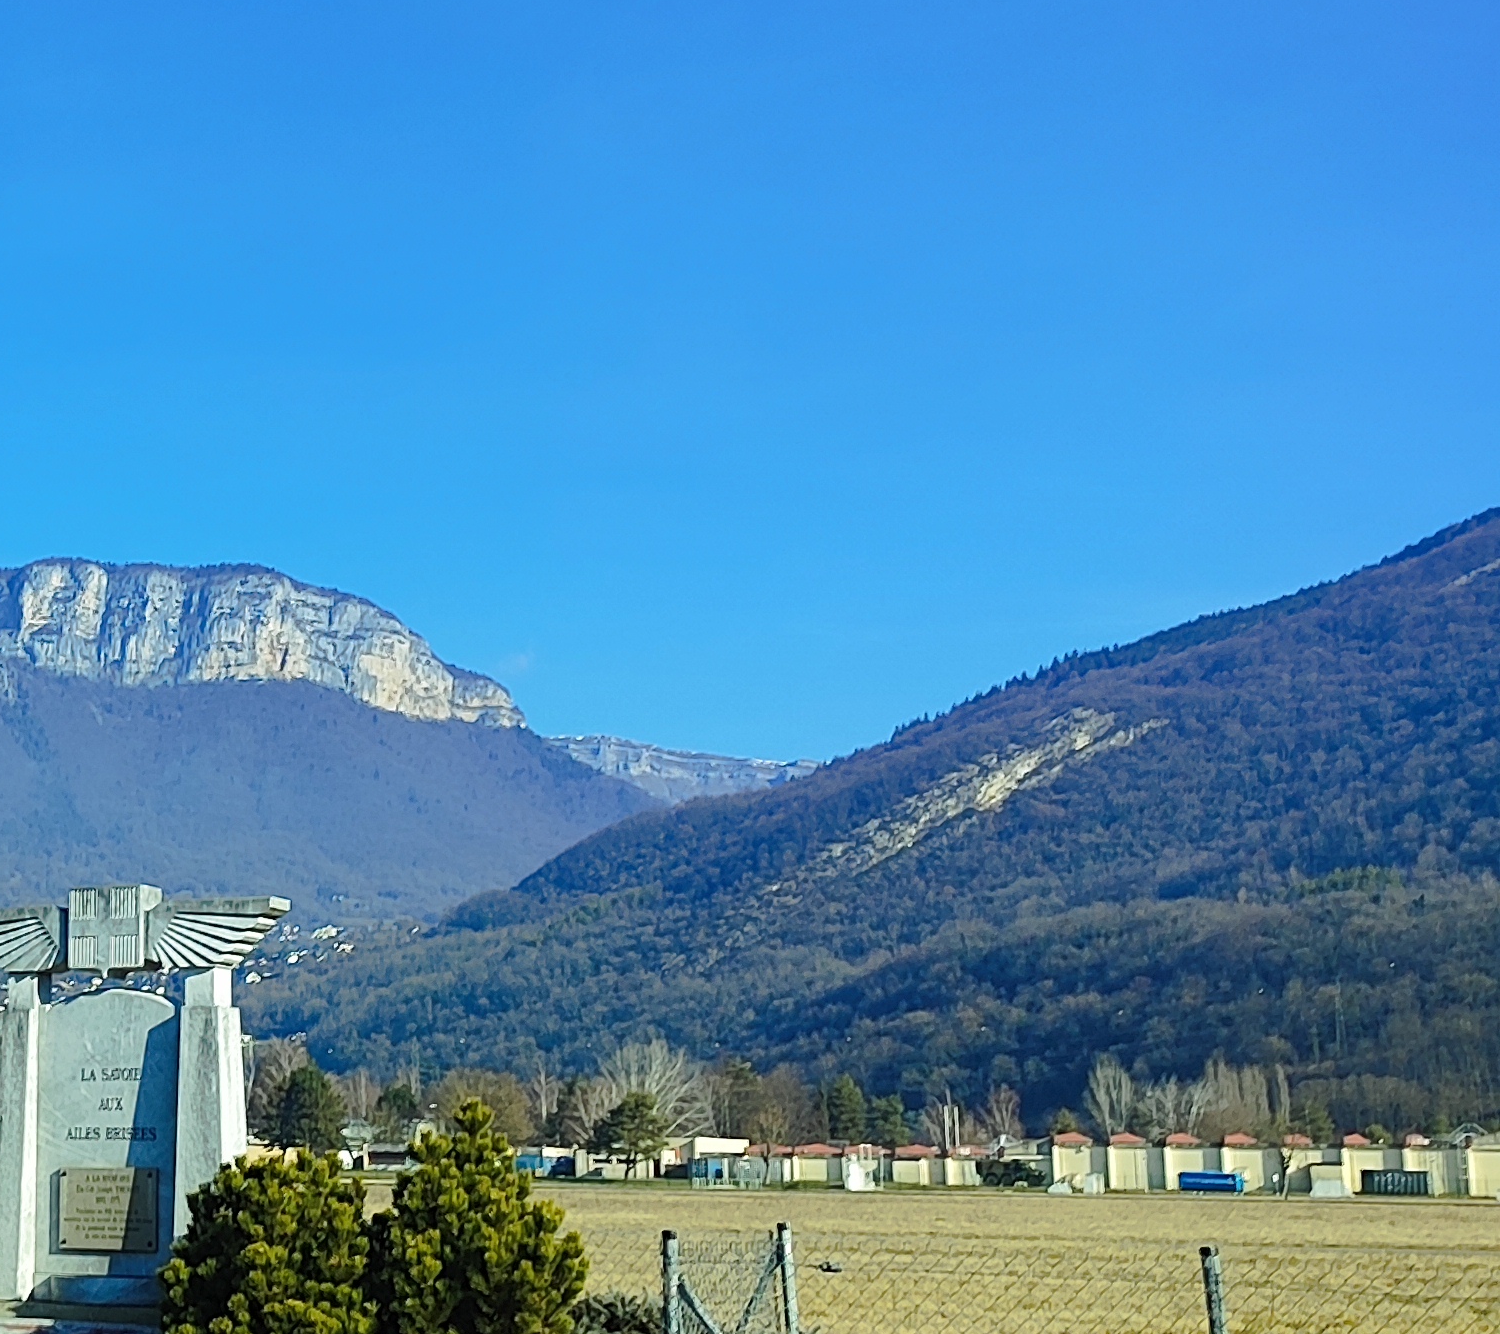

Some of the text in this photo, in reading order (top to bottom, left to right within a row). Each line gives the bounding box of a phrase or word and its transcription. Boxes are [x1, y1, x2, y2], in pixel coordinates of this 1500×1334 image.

[81, 1068, 142, 1082] LA SAVOIE
[98, 1097, 123, 1111] AUX
[65, 1127, 101, 1141] AILES
